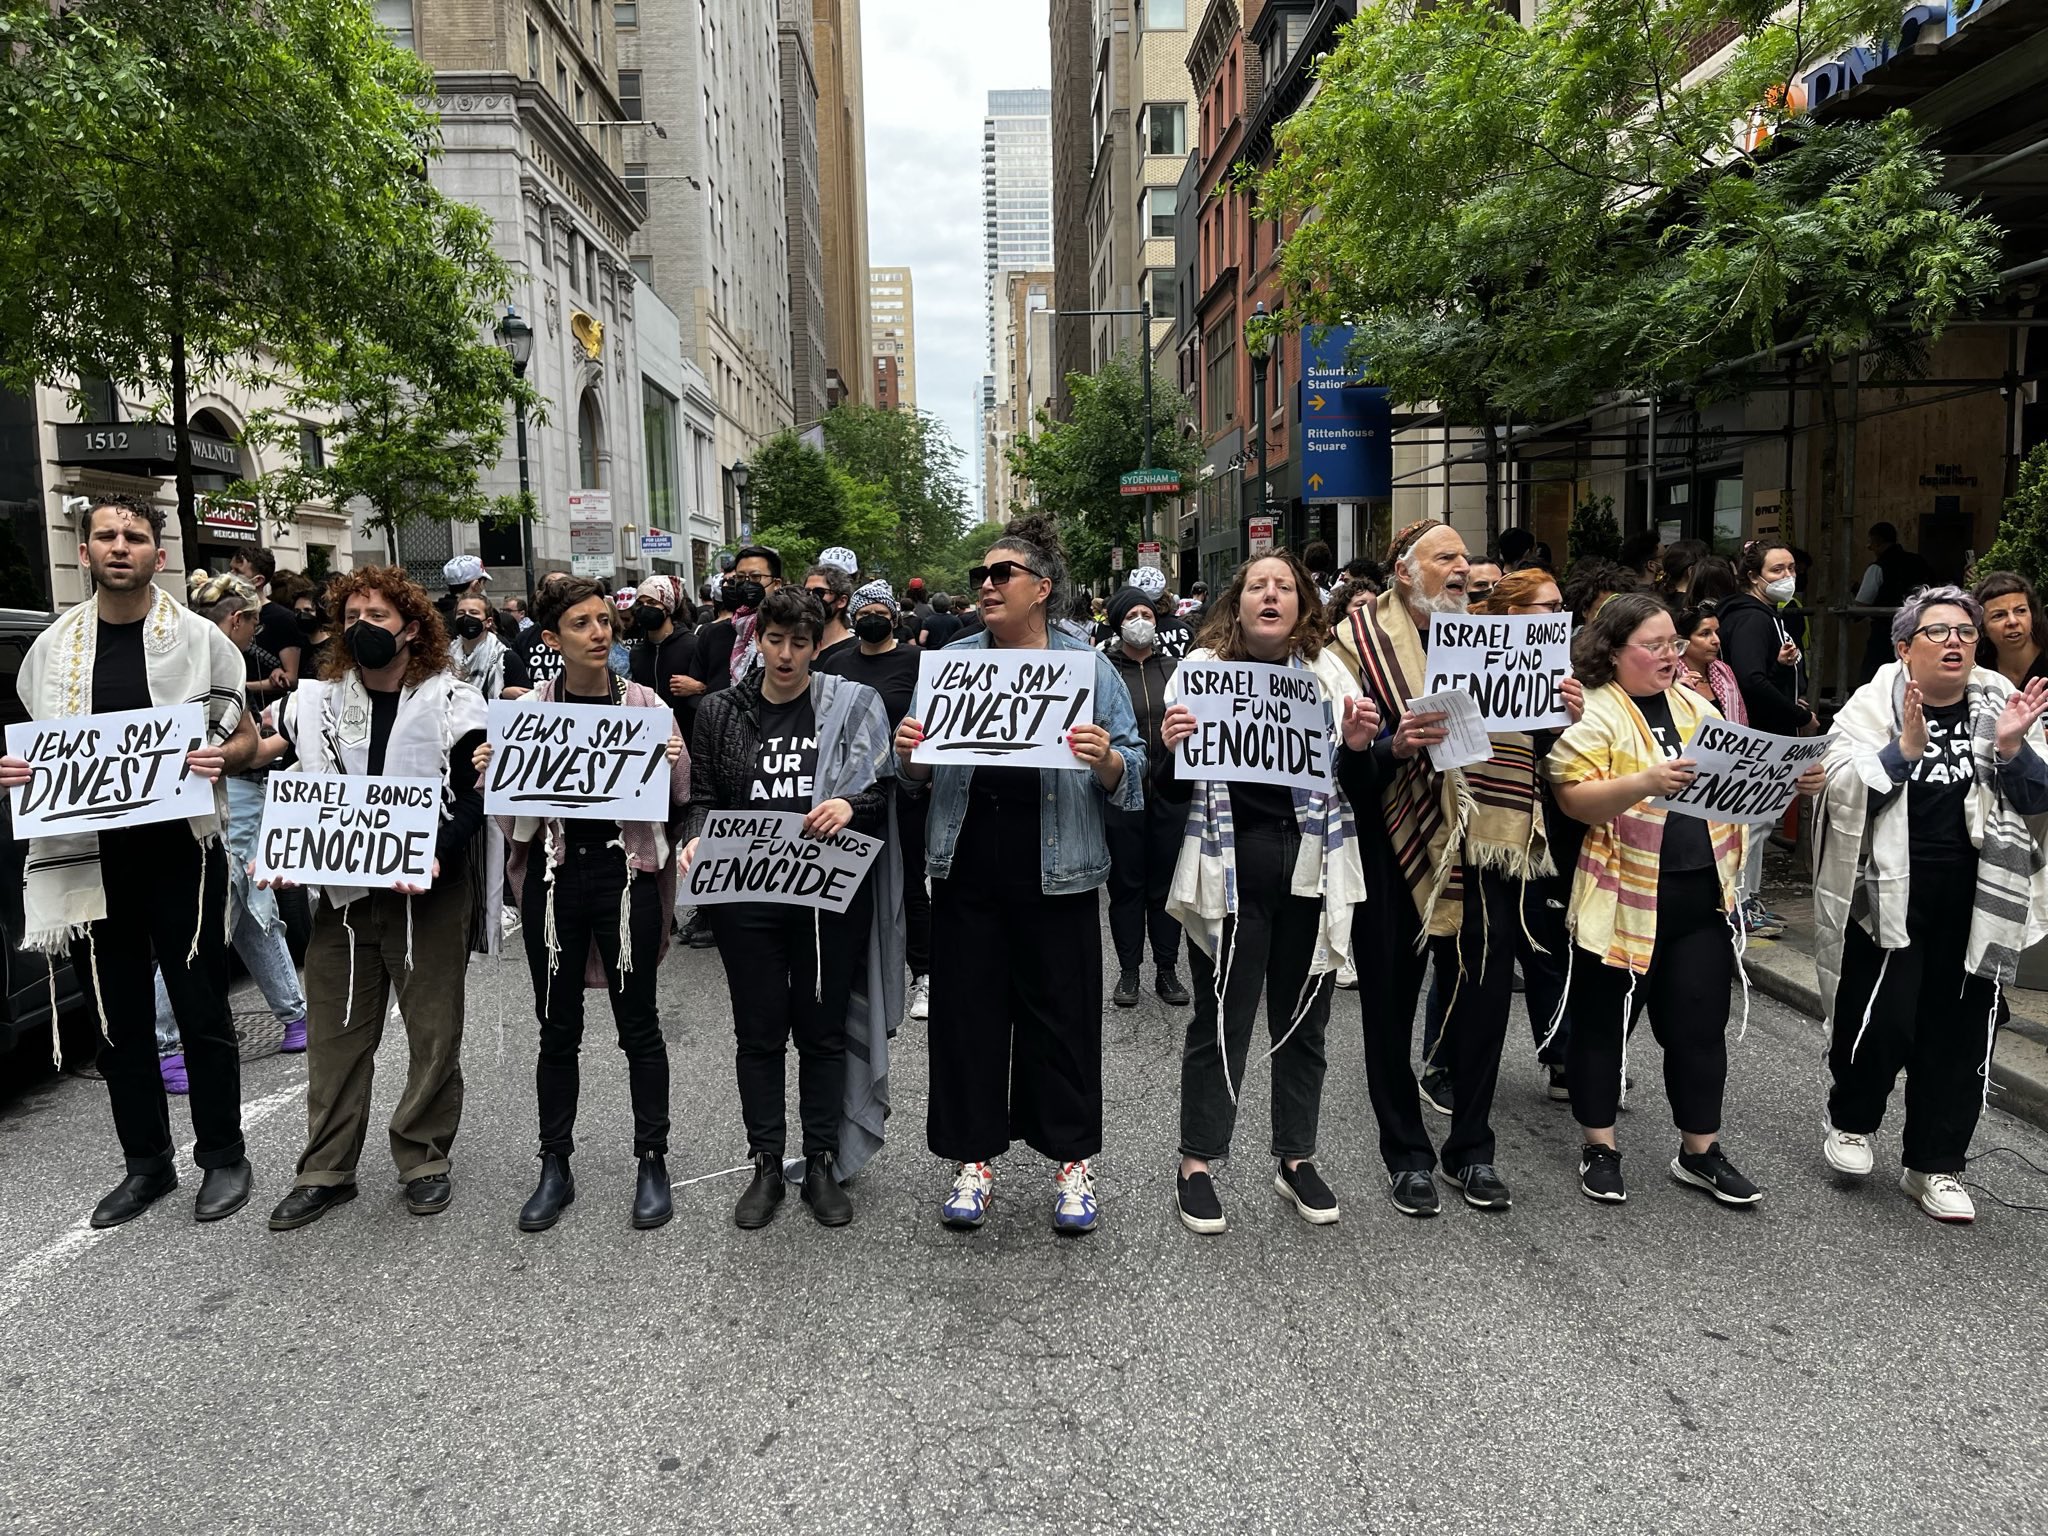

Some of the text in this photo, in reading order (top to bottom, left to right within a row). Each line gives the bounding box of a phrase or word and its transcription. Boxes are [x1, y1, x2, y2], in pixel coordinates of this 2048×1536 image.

[85, 431, 129, 450] 1512
[1307, 428, 1375, 438] Rittenhouse
[190, 439, 235, 464] WALNUT
[1307, 442, 1347, 453] Square
[1121, 474, 1178, 485] SYDENHAM ST
[1935, 463, 1962, 476] Night
[204, 502, 255, 523] CHIPOT
[213, 529, 257, 541] MEXICAN GRILL
[1153, 628, 1190, 645] EWS
[1435, 621, 1567, 650] ISRAEL BONDS
[1161, 642, 1187, 657] AY
[1484, 648, 1543, 671] FUND
[931, 660, 1072, 694] JEWS SAY:
[1183, 670, 1317, 705] ISRAEL BONDS
[921, 688, 1090, 745] DIVEST!
[1232, 698, 1291, 723] FUND
[24, 717, 181, 762] JEWS SAY:
[502, 711, 650, 748] JEWS SAY:
[790, 736, 817, 750] IN
[1183, 720, 1326, 778] GENOCIDE
[1696, 724, 1773, 763] ISRAEL
[1781, 739, 1832, 762] BONDS
[490, 743, 667, 798] DIVEST!
[754, 753, 803, 775] UR
[1729, 759, 1794, 781] FUND
[19, 738, 202, 815] DIVEST!
[750, 776, 813, 801] AME
[272, 780, 433, 809] ISRAEL BONDS
[318, 807, 390, 829] FUND
[707, 818, 783, 840] ISRAEL
[265, 827, 430, 875] GENOCIDE
[748, 839, 821, 860] FUND
[690, 856, 857, 902] GENOCIDE
